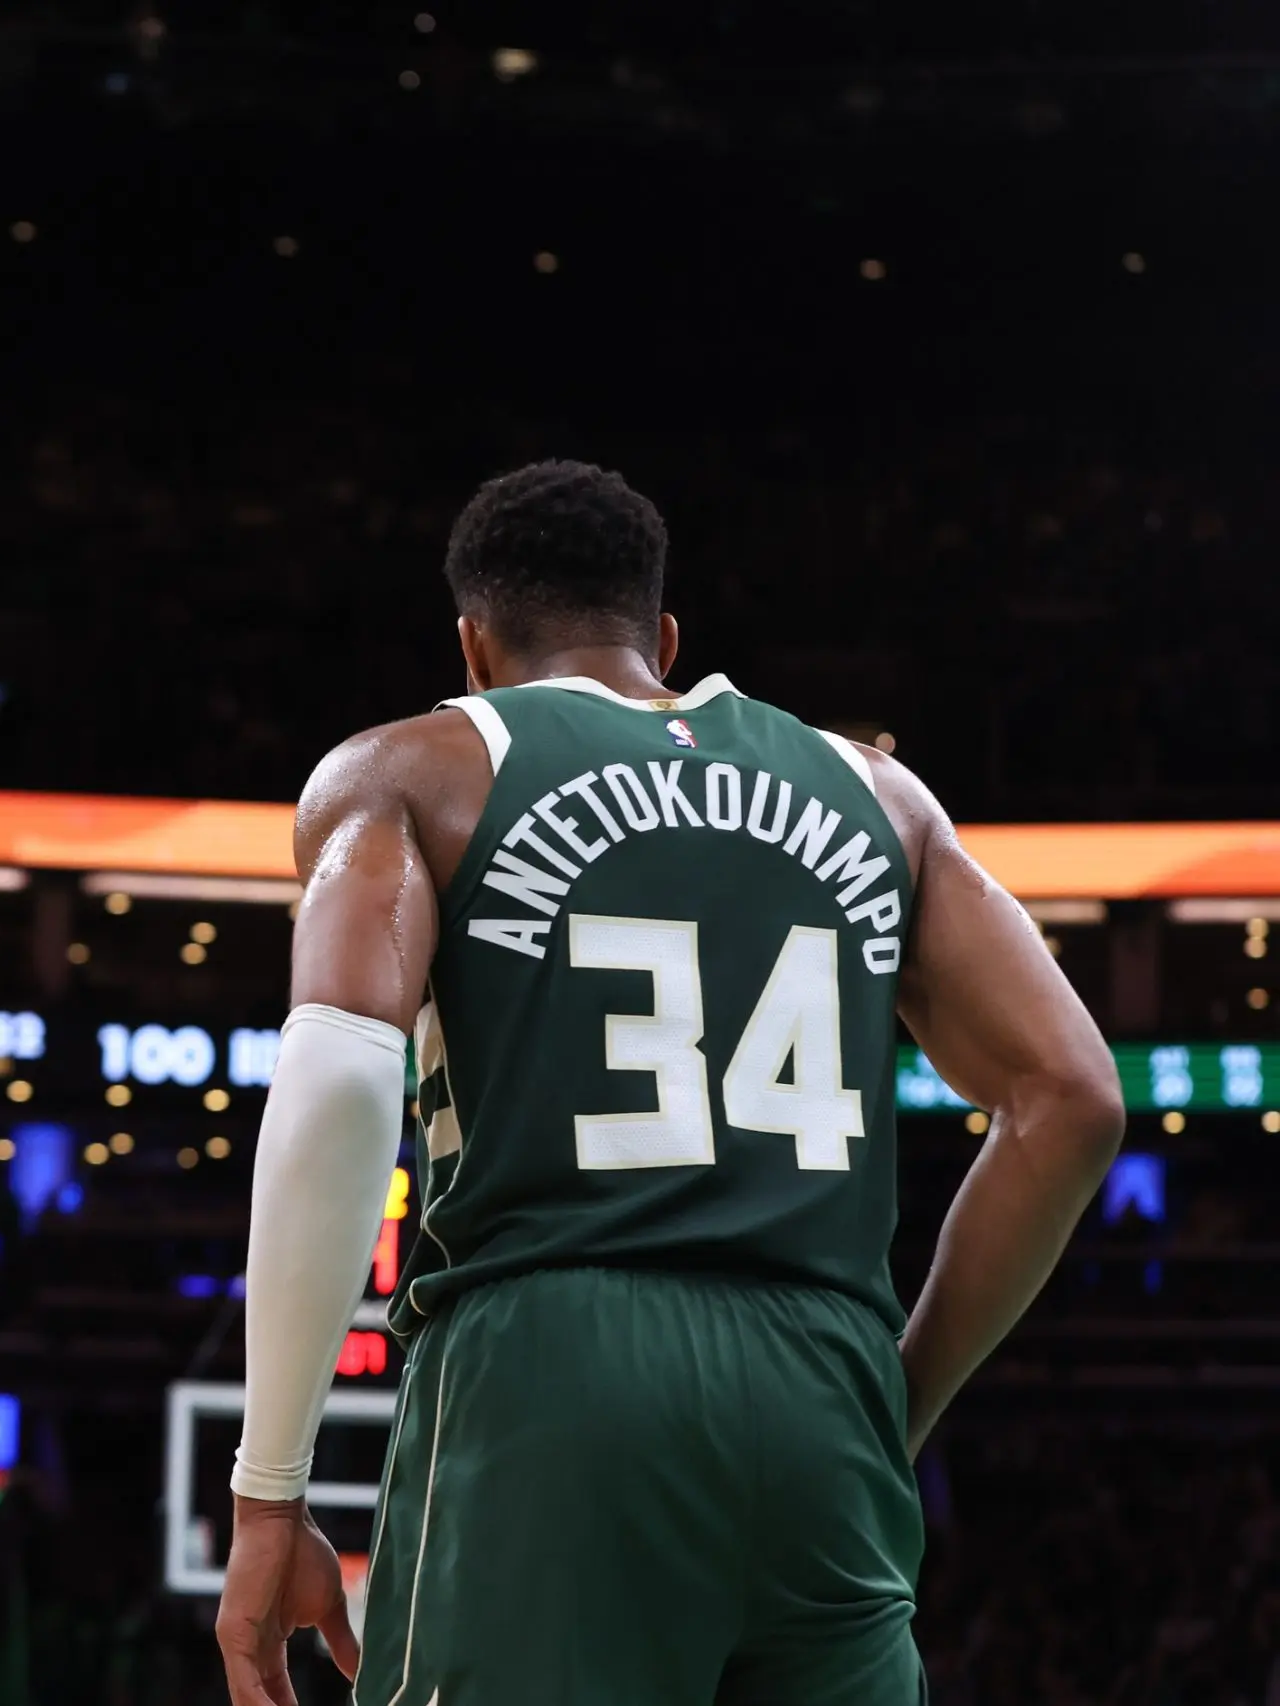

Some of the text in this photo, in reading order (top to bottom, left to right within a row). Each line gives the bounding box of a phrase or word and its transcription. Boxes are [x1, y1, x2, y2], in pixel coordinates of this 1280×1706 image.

[468, 760, 901, 974] ANTETOKOUNMPO
[97, 1022, 216, 1087] 100
[569, 913, 865, 1171] 34
